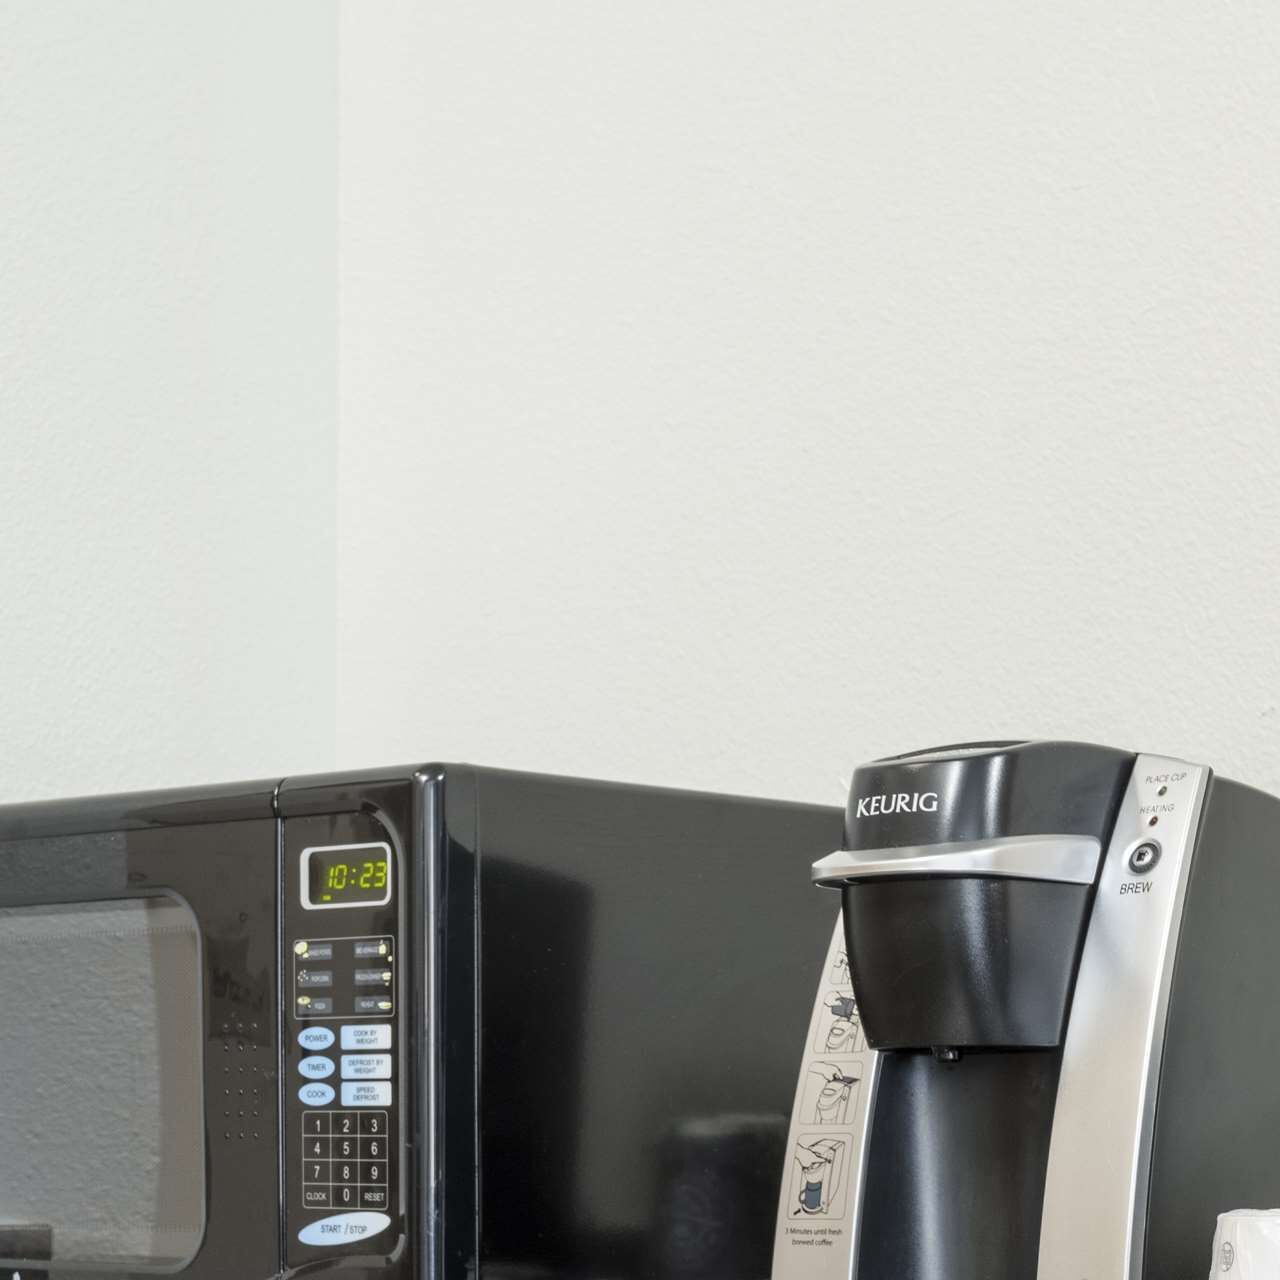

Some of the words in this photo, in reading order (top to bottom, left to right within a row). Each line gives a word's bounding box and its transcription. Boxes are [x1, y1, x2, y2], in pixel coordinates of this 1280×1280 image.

[1145, 774, 1170, 784] PLACE
[1171, 772, 1187, 782] CUP
[856, 792, 938, 819] KEURIG
[1140, 804, 1175, 814] HEATING
[327, 862, 388, 889] 10:23
[1120, 882, 1153, 895] BREW
[304, 1033, 329, 1042] POWER
[353, 1029, 368, 1037] COOK
[307, 1063, 327, 1072] TIMER
[306, 1090, 326, 1098] COOK
[356, 1086, 375, 1094] SPEED
[315, 1119, 321, 1132] 1
[343, 1119, 350, 1133] 2
[371, 1119, 378, 1133] 3
[313, 1142, 321, 1155] 4
[343, 1142, 350, 1155] 5
[371, 1142, 378, 1155] 6
[314, 1165, 320, 1178] 7
[343, 1166, 350, 1179] 8
[371, 1166, 378, 1179] 9
[306, 1192, 327, 1201] CLOCK
[343, 1189, 350, 1202] 0
[364, 1192, 385, 1201] RESET
[320, 1224, 342, 1234] START
[790, 1227, 813, 1235] Minutes
[815, 1238, 832, 1246] coffee
